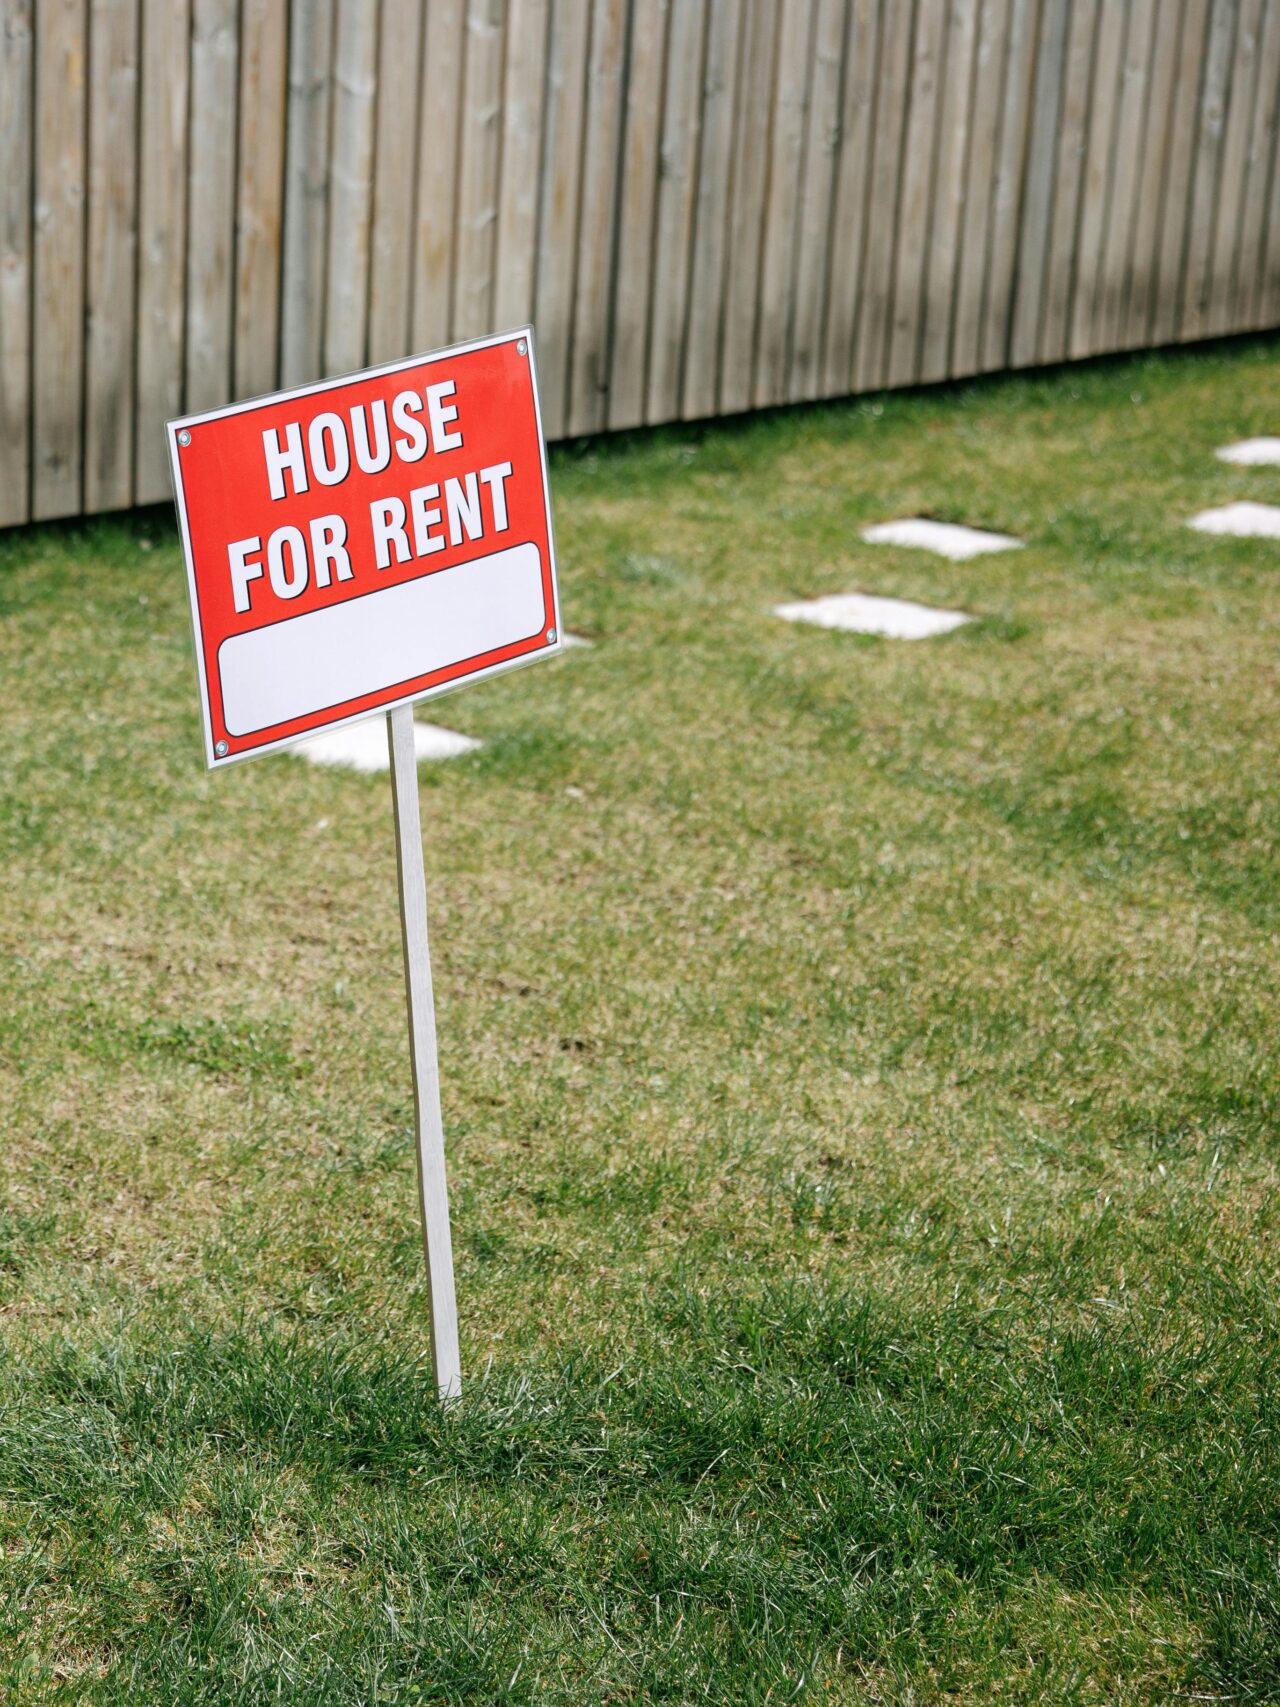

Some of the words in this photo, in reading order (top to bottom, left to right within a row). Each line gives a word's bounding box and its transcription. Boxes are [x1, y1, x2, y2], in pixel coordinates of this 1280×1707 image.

[262, 380, 463, 500] HOUSE
[227, 514, 354, 613] FOR
[369, 461, 513, 570] RENT
